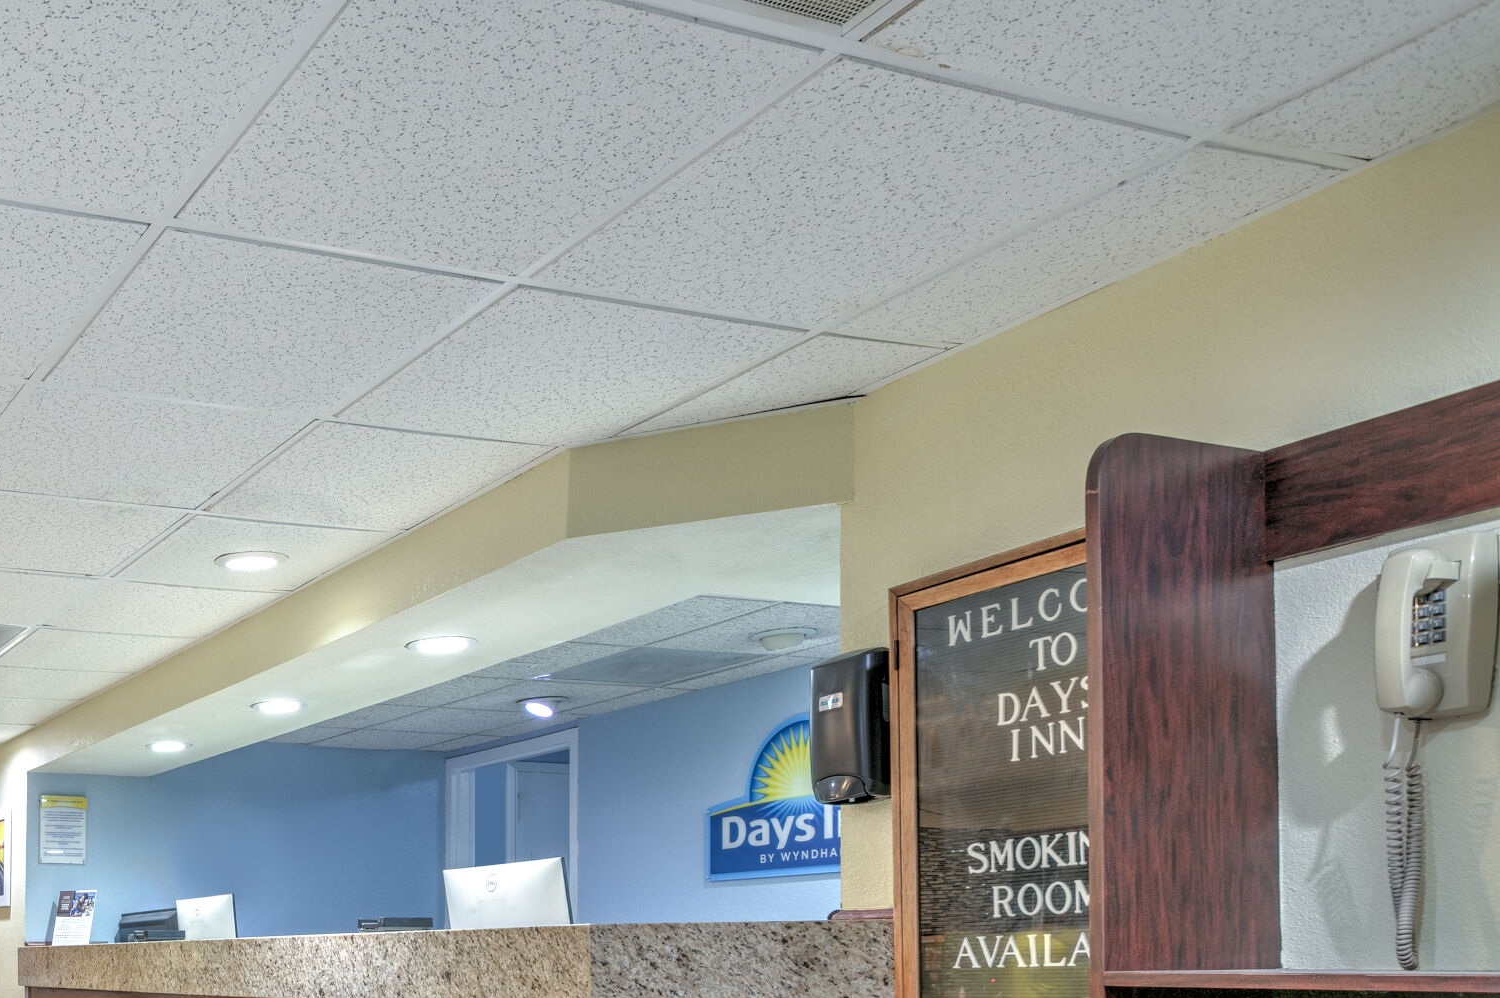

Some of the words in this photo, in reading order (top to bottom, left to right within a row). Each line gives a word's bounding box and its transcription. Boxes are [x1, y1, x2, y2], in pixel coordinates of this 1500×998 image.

[948, 578, 1088, 647] WELCO
[1029, 631, 1078, 671] TO
[1010, 716, 1086, 762] INN
[722, 813, 816, 850] Days
[760, 853, 775, 864] BY
[780, 847, 839, 862] WYNDHA
[967, 830, 1090, 874] SMOKI
[992, 879, 1090, 919] ROOM
[952, 931, 1090, 969] AVAILA
